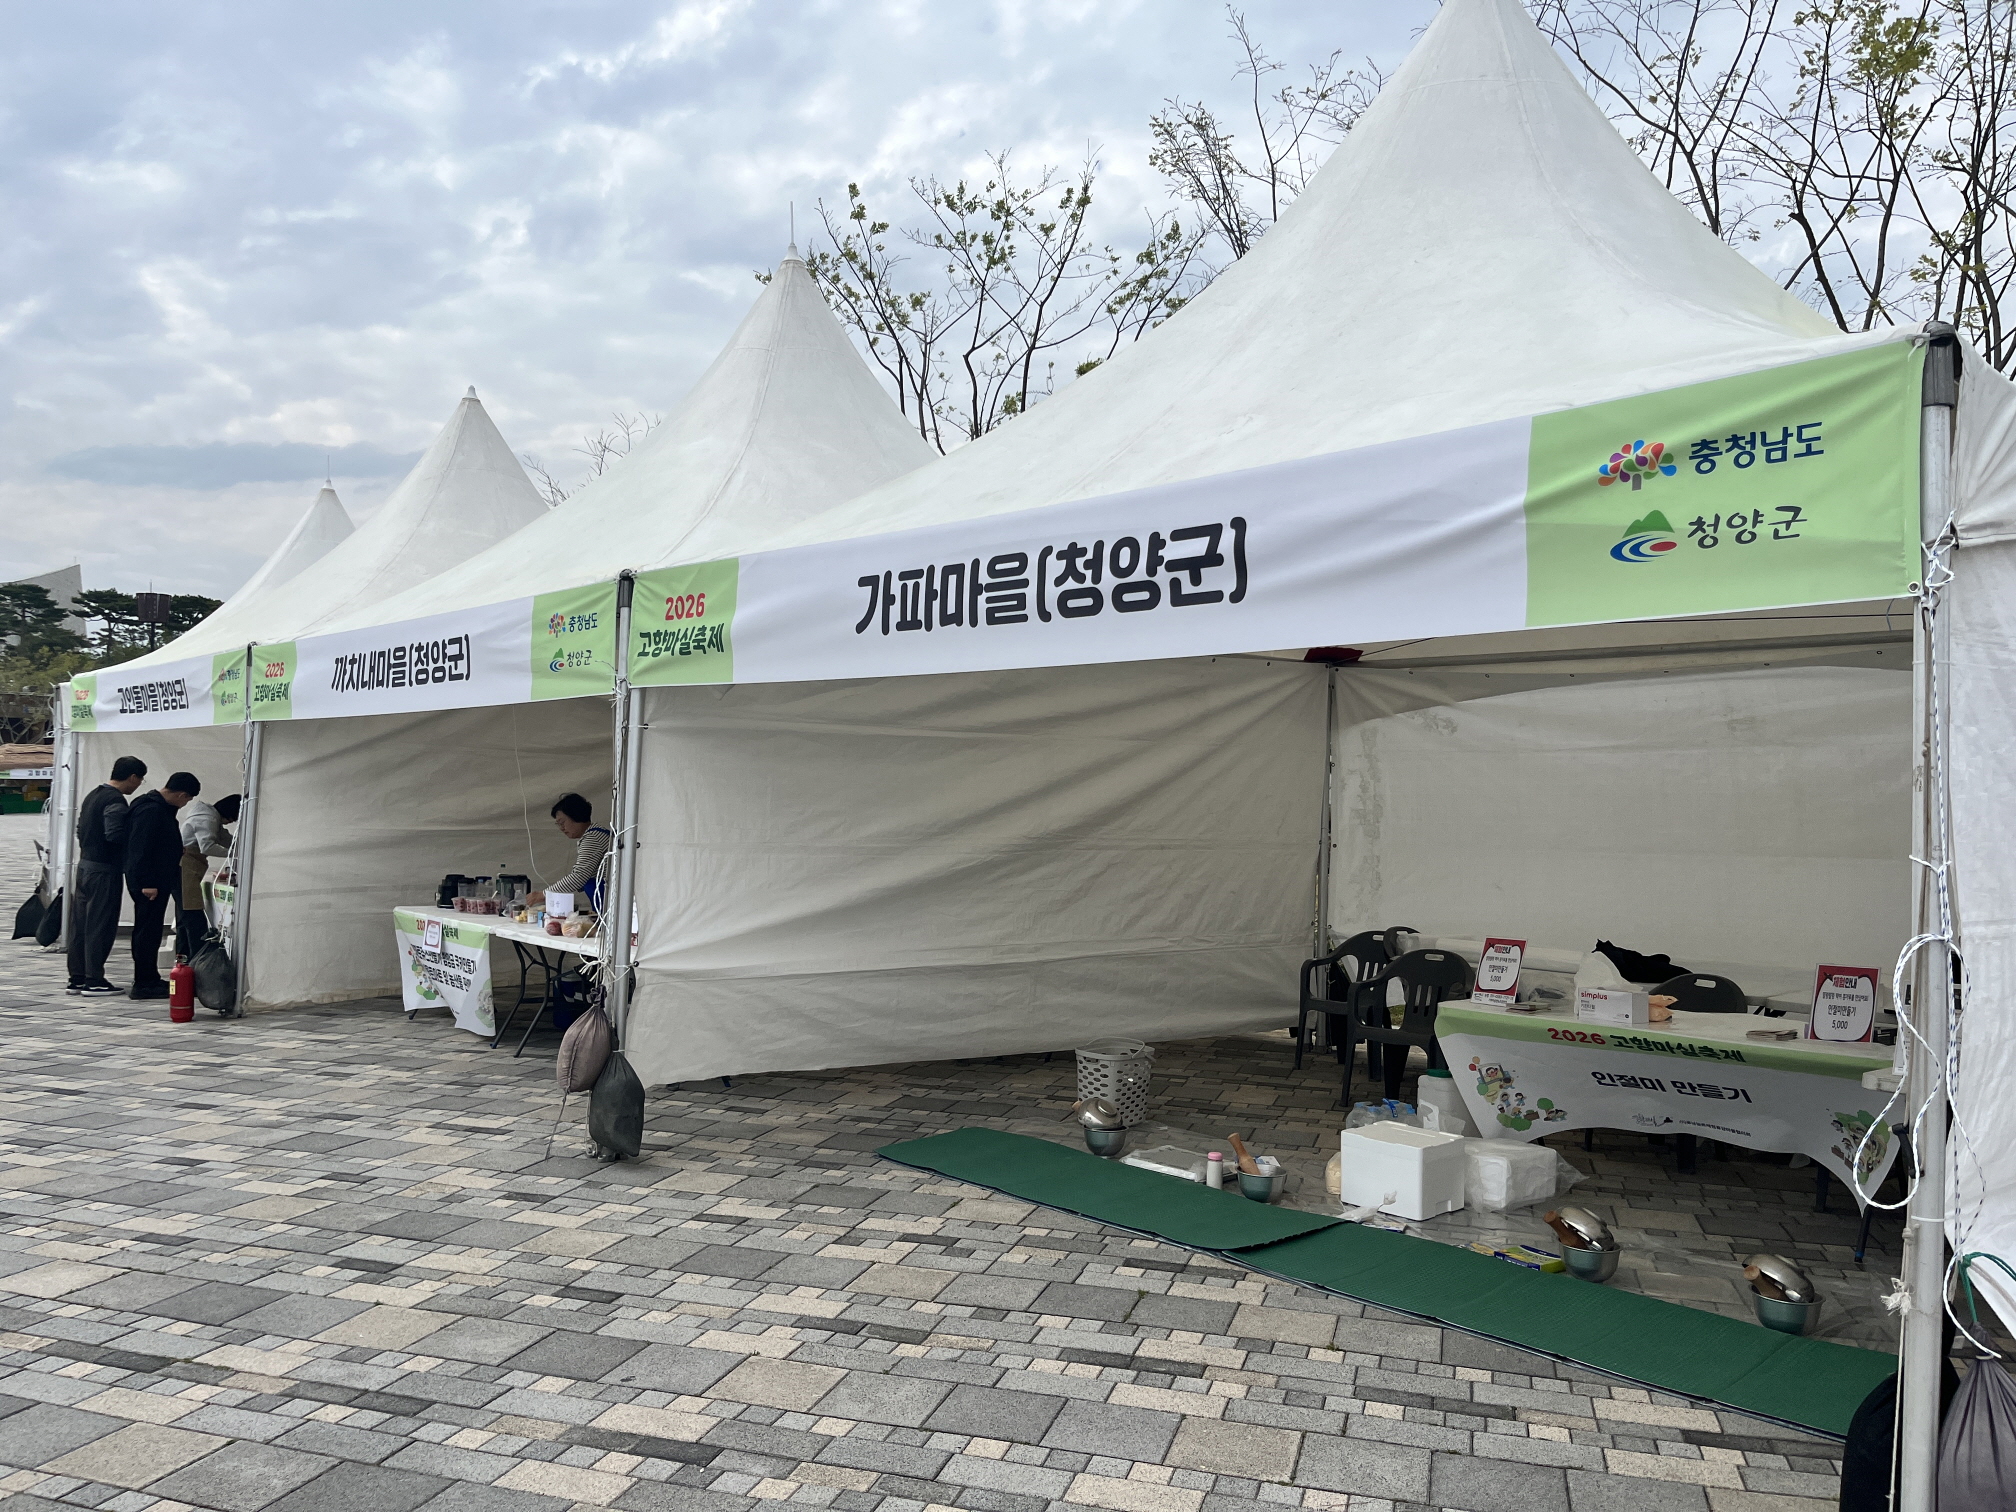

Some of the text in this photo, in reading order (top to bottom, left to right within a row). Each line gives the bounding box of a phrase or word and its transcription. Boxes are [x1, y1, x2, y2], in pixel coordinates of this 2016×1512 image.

[1688, 421, 1825, 475] 충청남도
[1687, 505, 1808, 549] 청양군
[855, 516, 1247, 636] 가파마을(청양군)
[665, 592, 706, 621] 2026
[568, 612, 598, 633] 충청남도
[637, 622, 725, 657] 고향마실축제
[265, 661, 285, 678] 2026
[331, 634, 471, 693] 까치내마을(청양군)
[566, 649, 592, 668] 청양군
[253, 681, 290, 702] 고향마실축제
[1580, 990, 1608, 1000] simplus
[1832, 976, 1858, 989] 체험안내
[1827, 1004, 1857, 1017] 인절미만들기
[1831, 1019, 1849, 1030] 5,000
[1547, 1027, 1747, 1063] 2026 고향마실축제
[1590, 1071, 1753, 1104] 인절미 만들기
